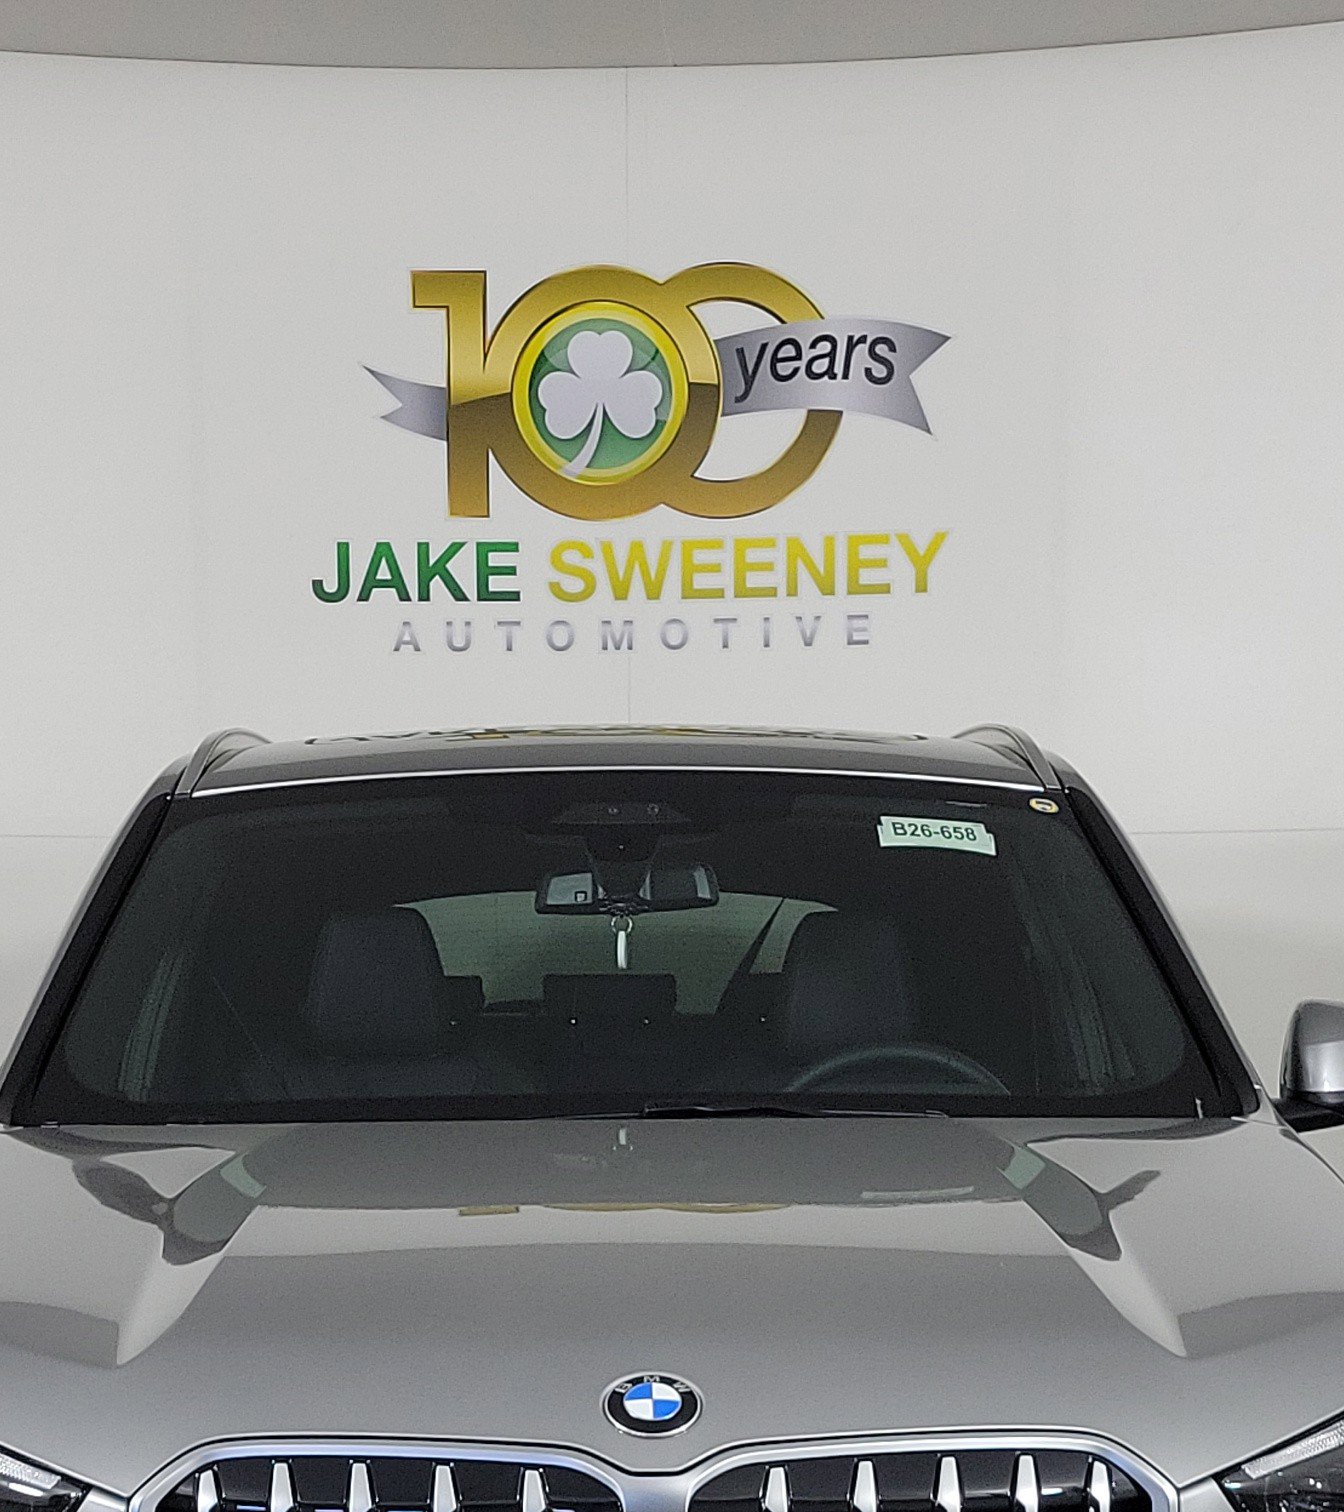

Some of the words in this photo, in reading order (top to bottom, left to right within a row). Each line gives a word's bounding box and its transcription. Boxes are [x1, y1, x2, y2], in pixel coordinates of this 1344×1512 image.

[735, 329, 897, 402] years
[311, 541, 521, 602] JAKE
[548, 531, 948, 602] SWEENEY
[393, 614, 871, 652] AUTOMOTIVE
[891, 821, 977, 841] B26-658
